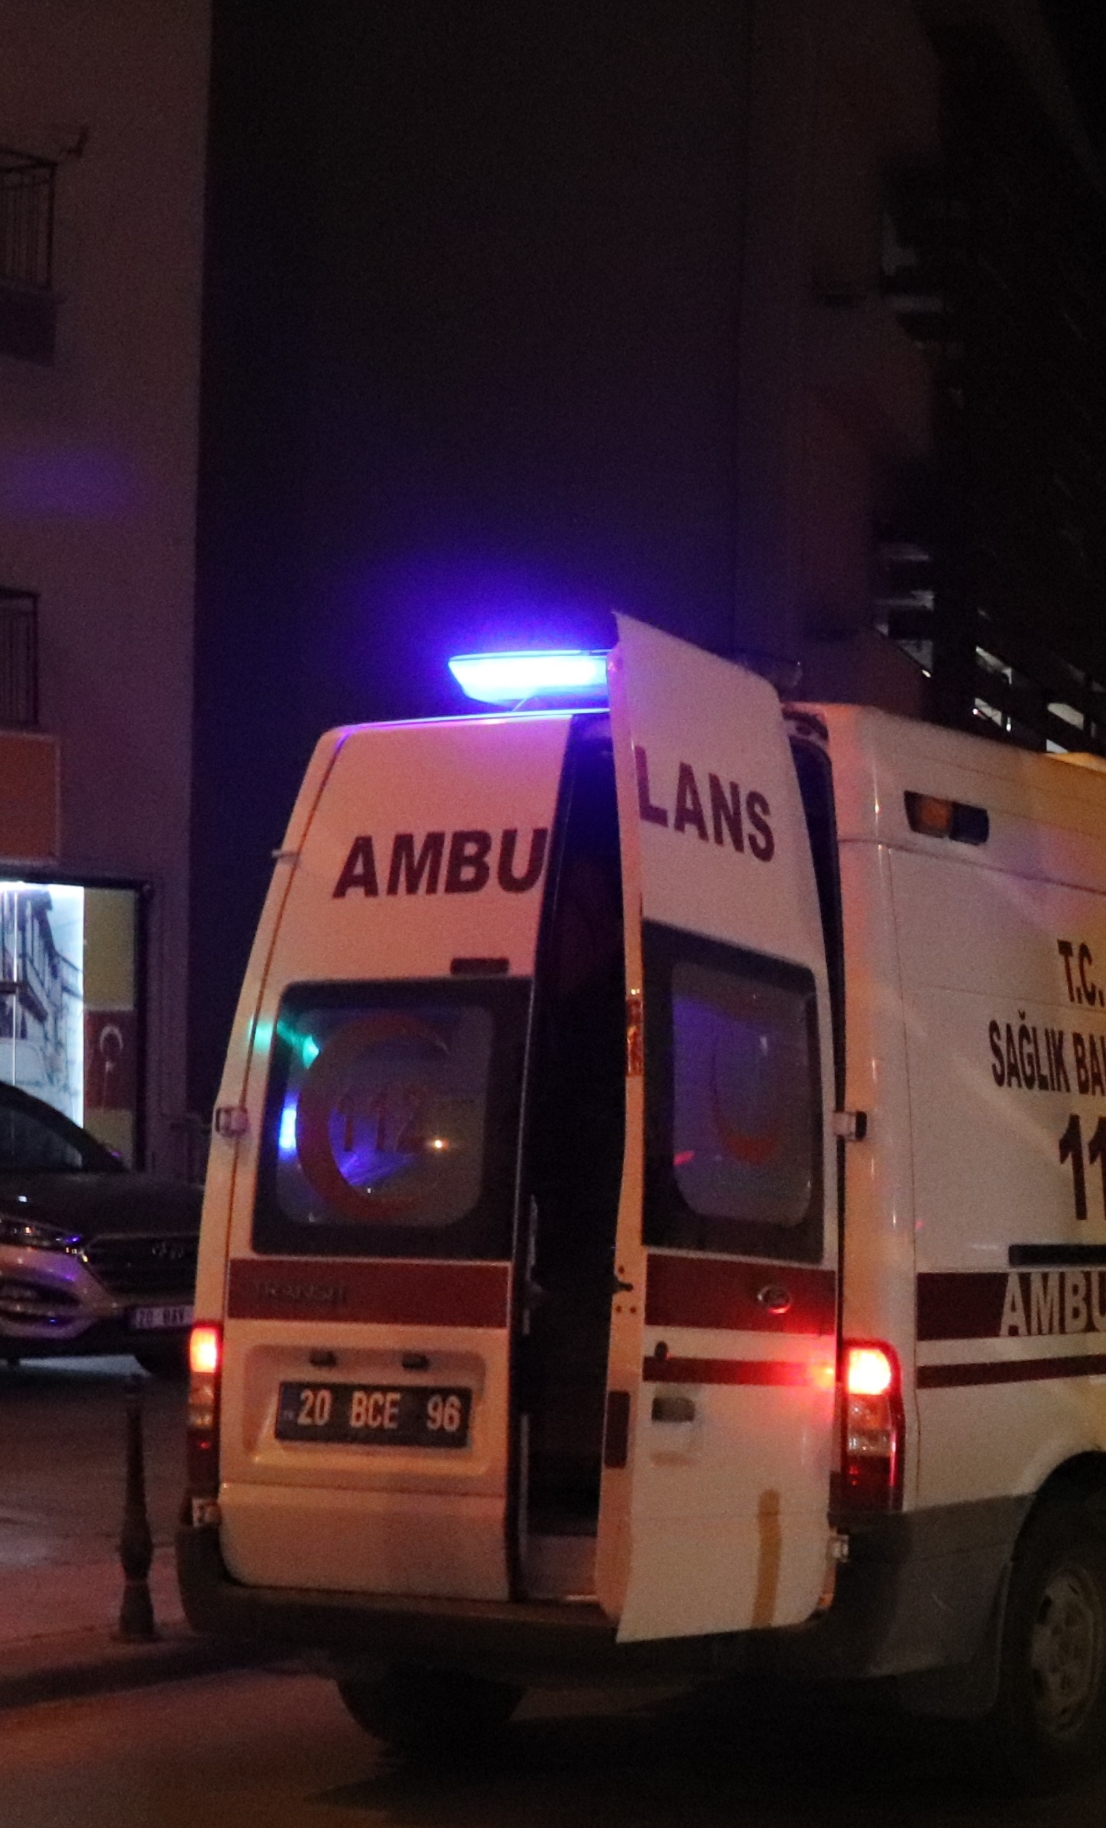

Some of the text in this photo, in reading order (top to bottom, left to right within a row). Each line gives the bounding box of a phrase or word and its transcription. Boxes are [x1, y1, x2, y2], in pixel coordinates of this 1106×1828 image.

[332, 828, 548, 899] AMBU
[1057, 939, 1105, 1007] T.C.
[989, 1009, 1071, 1093] SAĞLIK
[297, 1388, 463, 1433] 20 BCE 96
